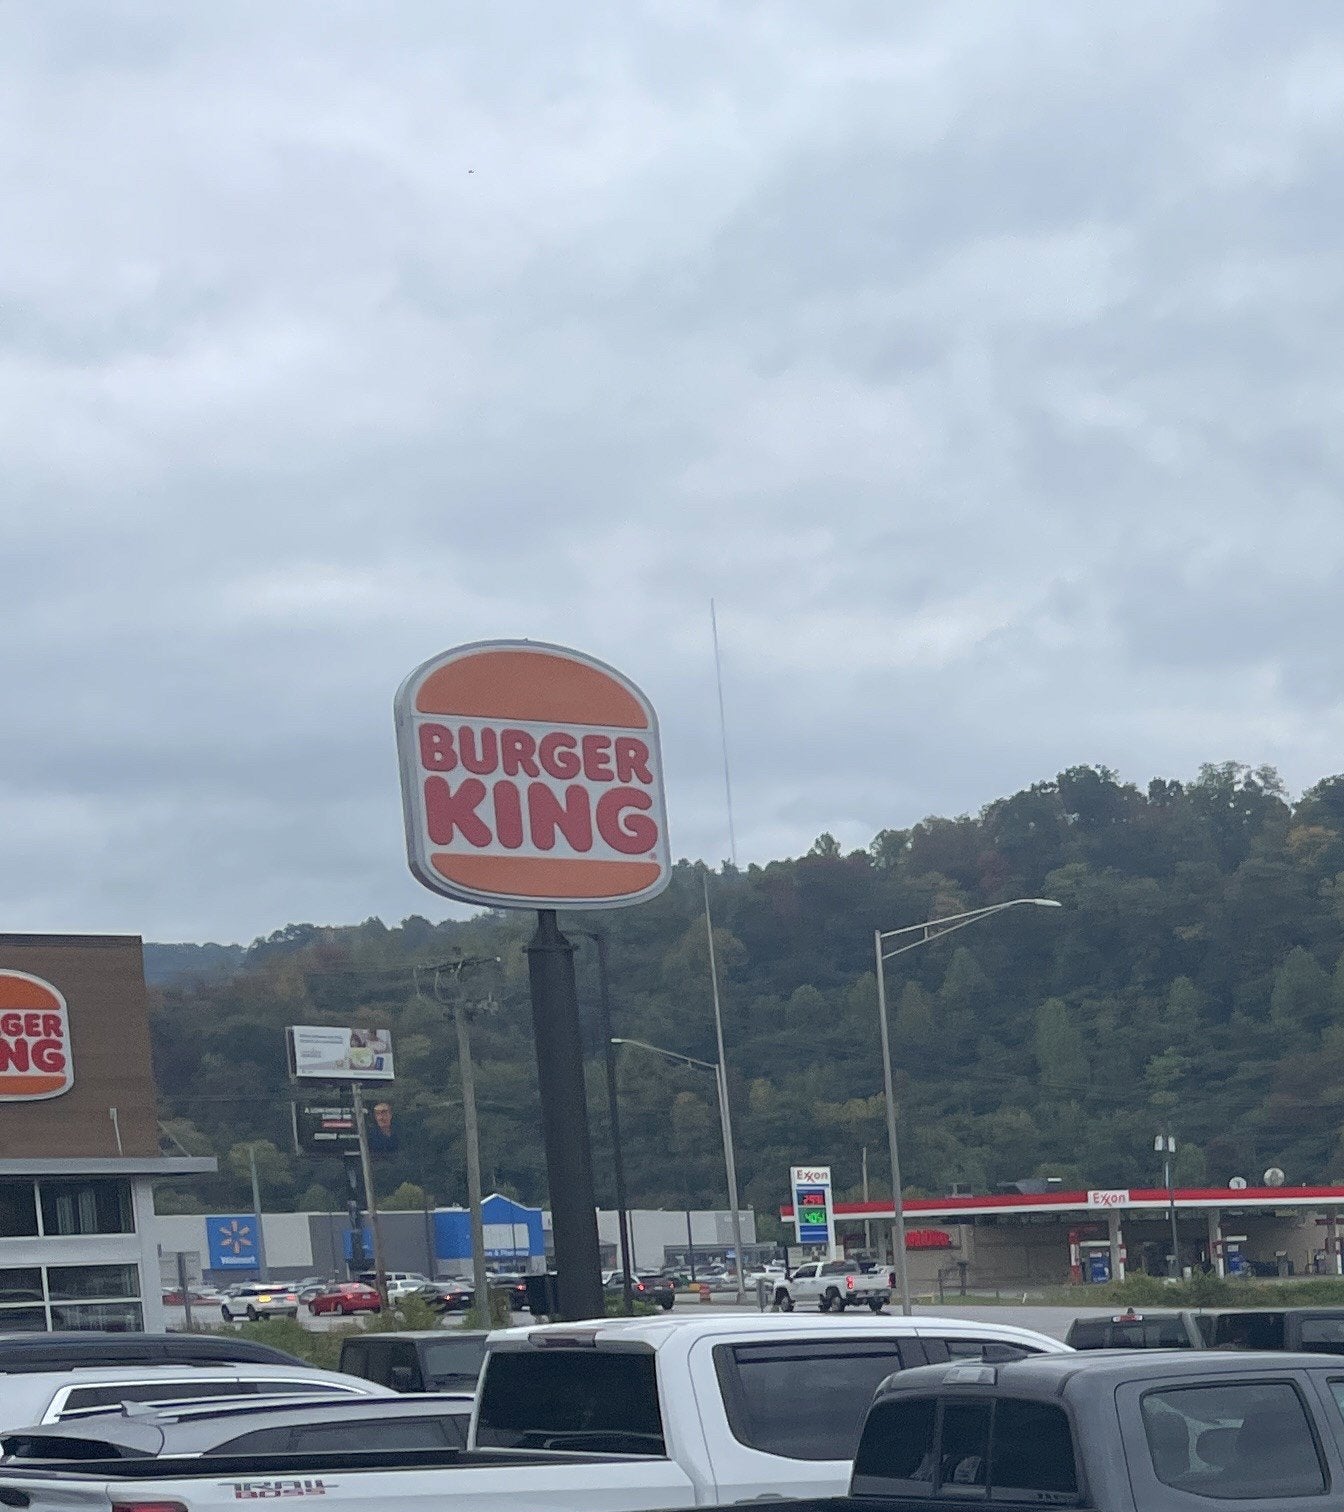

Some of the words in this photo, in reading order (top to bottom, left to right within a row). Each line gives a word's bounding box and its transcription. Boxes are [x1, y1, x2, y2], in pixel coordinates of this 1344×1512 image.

[418, 723, 653, 784] BURGER
[423, 776, 659, 855] KING
[0, 1013, 64, 1038] GER
[0, 1038, 66, 1073] NG
[796, 1169, 829, 1184] Exxon
[1093, 1192, 1126, 1207] Exxon
